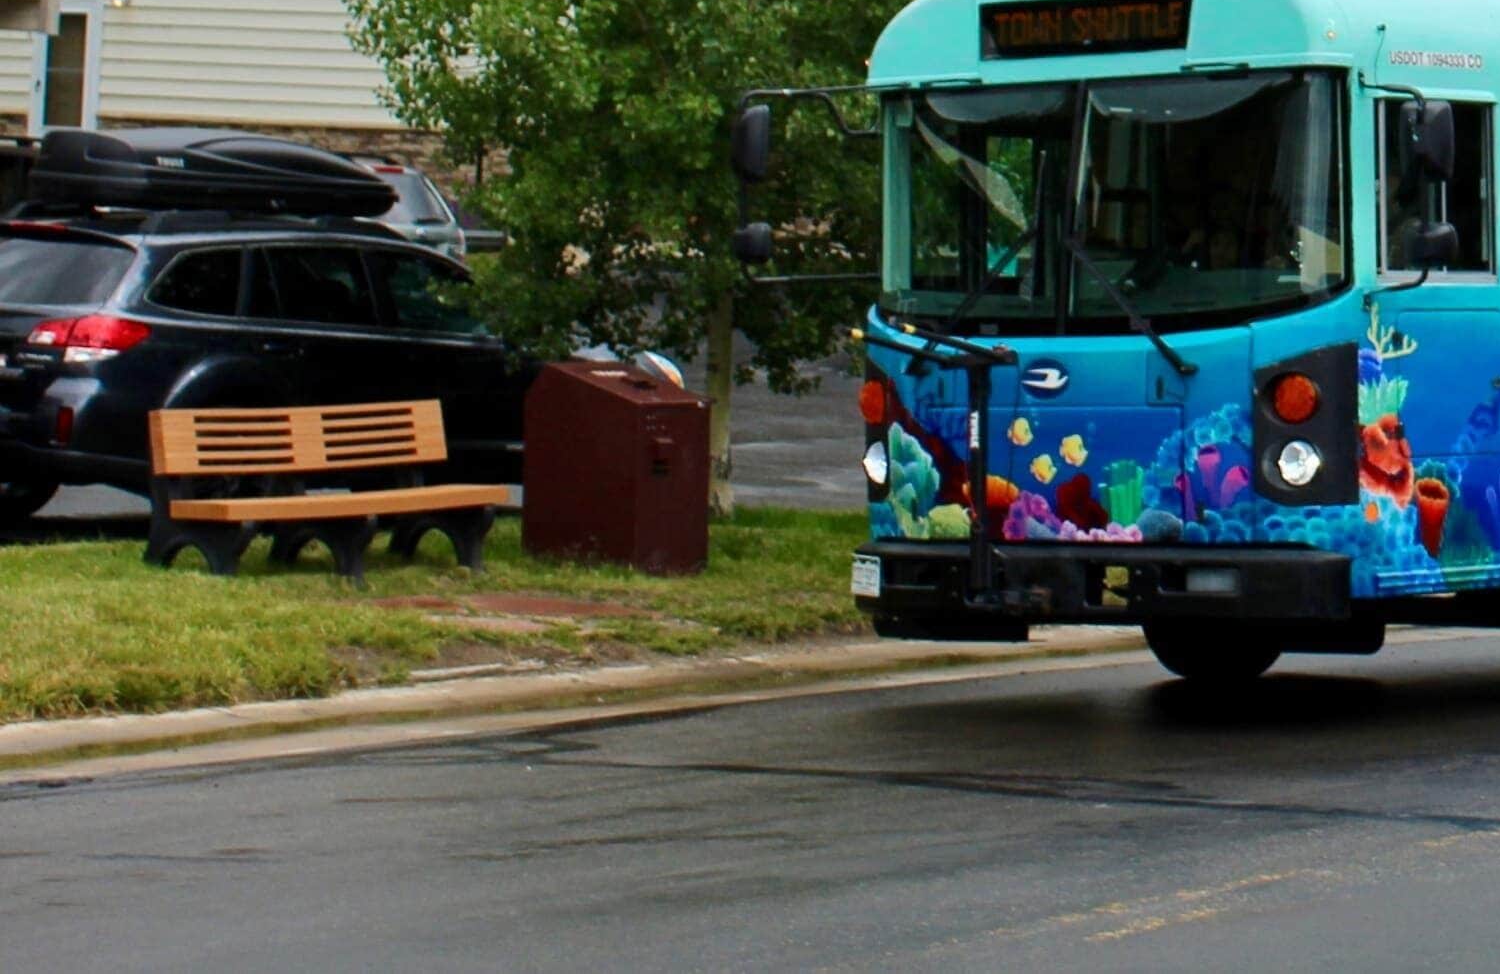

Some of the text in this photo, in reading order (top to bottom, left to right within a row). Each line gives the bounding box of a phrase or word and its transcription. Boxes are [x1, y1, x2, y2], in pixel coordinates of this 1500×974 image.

[994, 1, 1183, 45] TOWN SHUTTLE
[1389, 51, 1424, 65] USDOT
